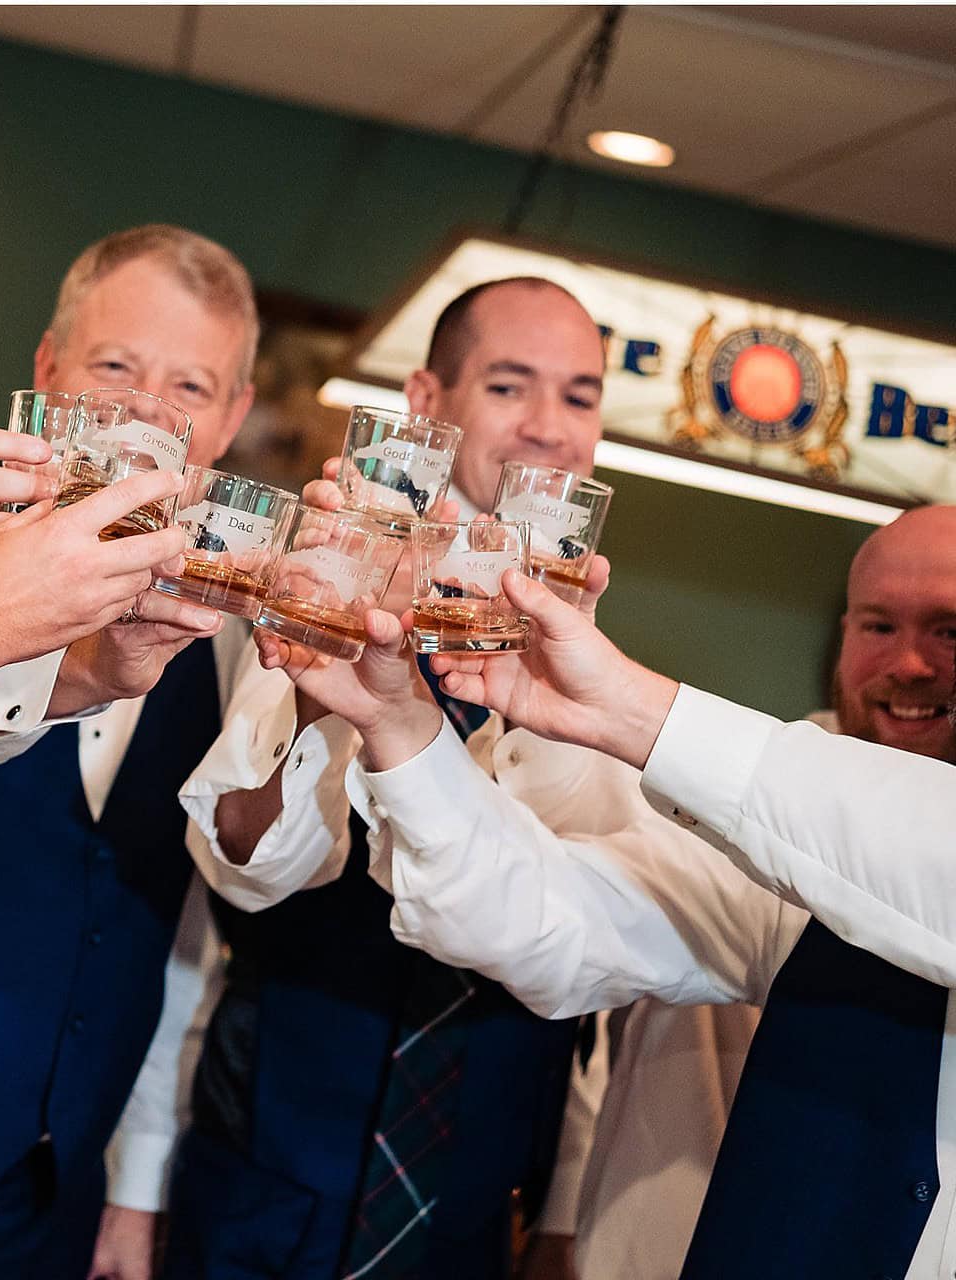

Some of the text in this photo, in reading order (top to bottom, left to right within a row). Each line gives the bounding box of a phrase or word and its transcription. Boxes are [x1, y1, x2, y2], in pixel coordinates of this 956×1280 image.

[141, 431, 179, 459] Groom
[383, 447, 441, 470] Godfher
[228, 517, 254, 533] Dad
